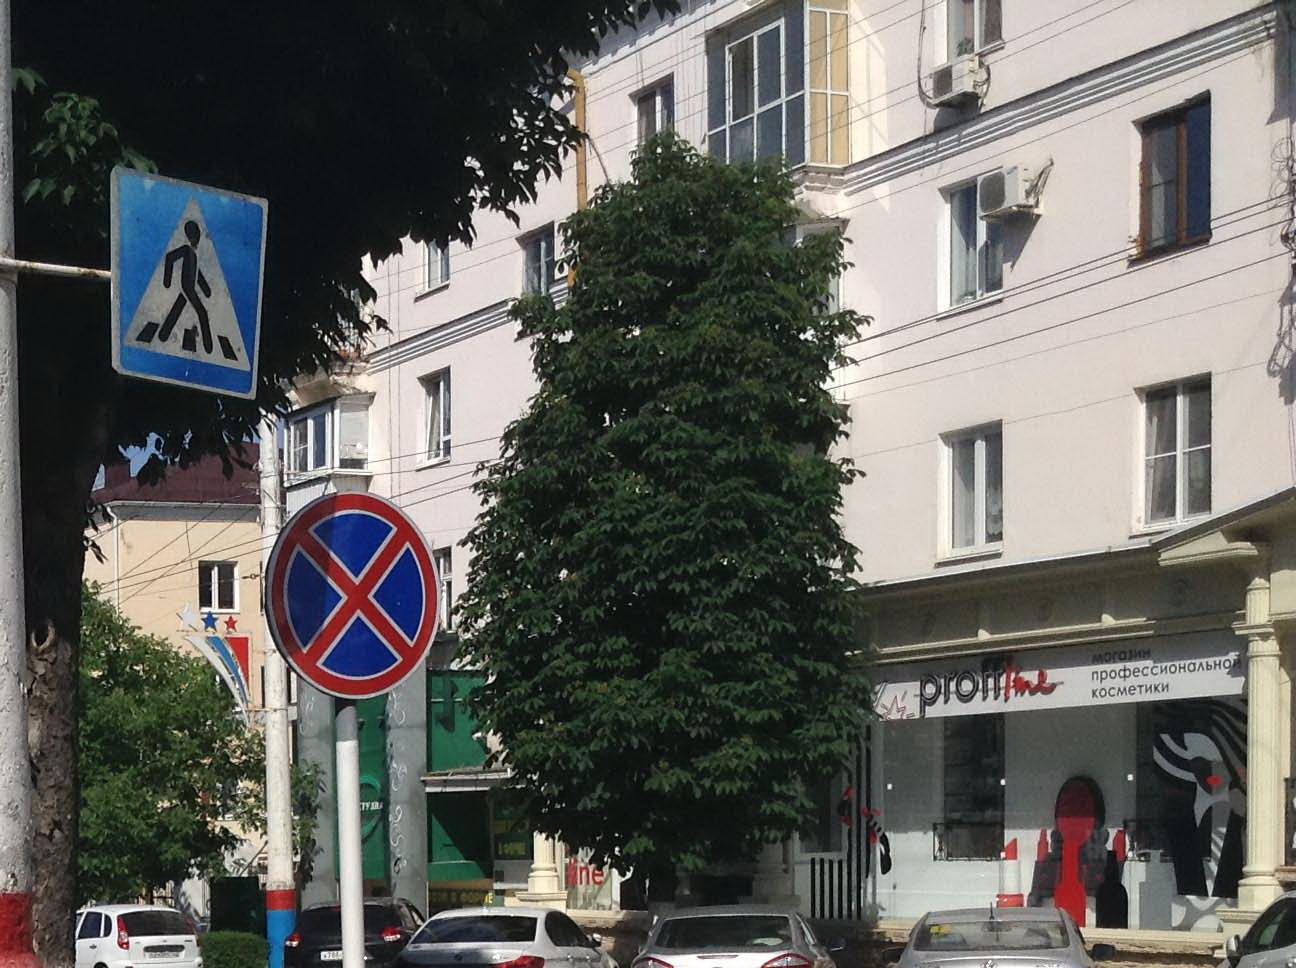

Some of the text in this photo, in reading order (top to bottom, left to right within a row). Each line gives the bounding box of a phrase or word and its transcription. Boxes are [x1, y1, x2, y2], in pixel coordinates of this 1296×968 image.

[1092, 649, 1151, 664] магазин
[1091, 656, 1242, 684] профессиональной
[1091, 683, 1169, 699] косметики
